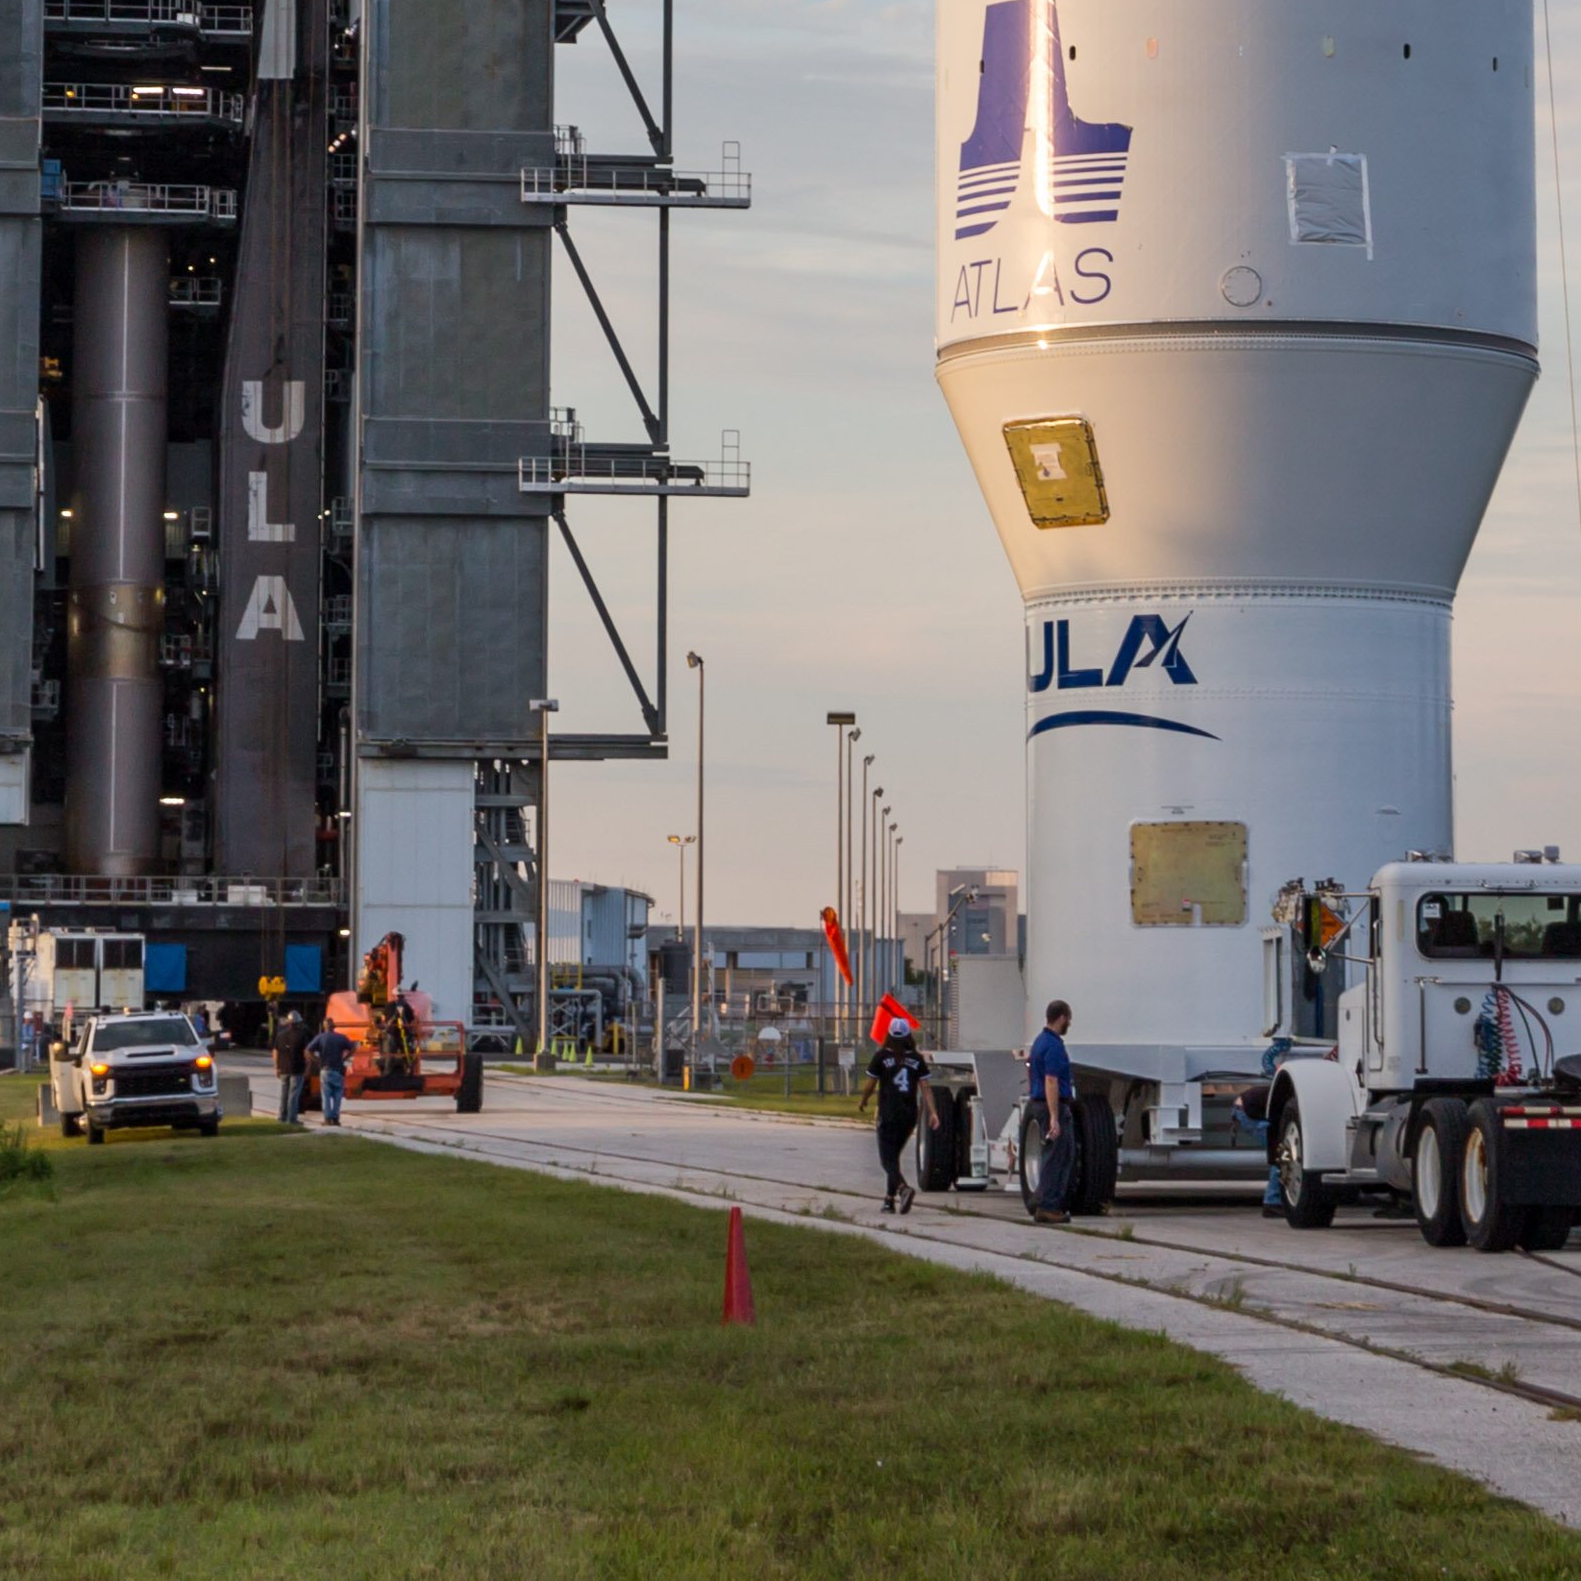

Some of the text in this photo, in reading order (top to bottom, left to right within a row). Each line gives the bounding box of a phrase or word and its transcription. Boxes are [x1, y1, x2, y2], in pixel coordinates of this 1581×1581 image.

[950, 248, 1113, 323] ATLAS
[235, 380, 305, 641] ULA
[893, 1067, 909, 1092] 4
